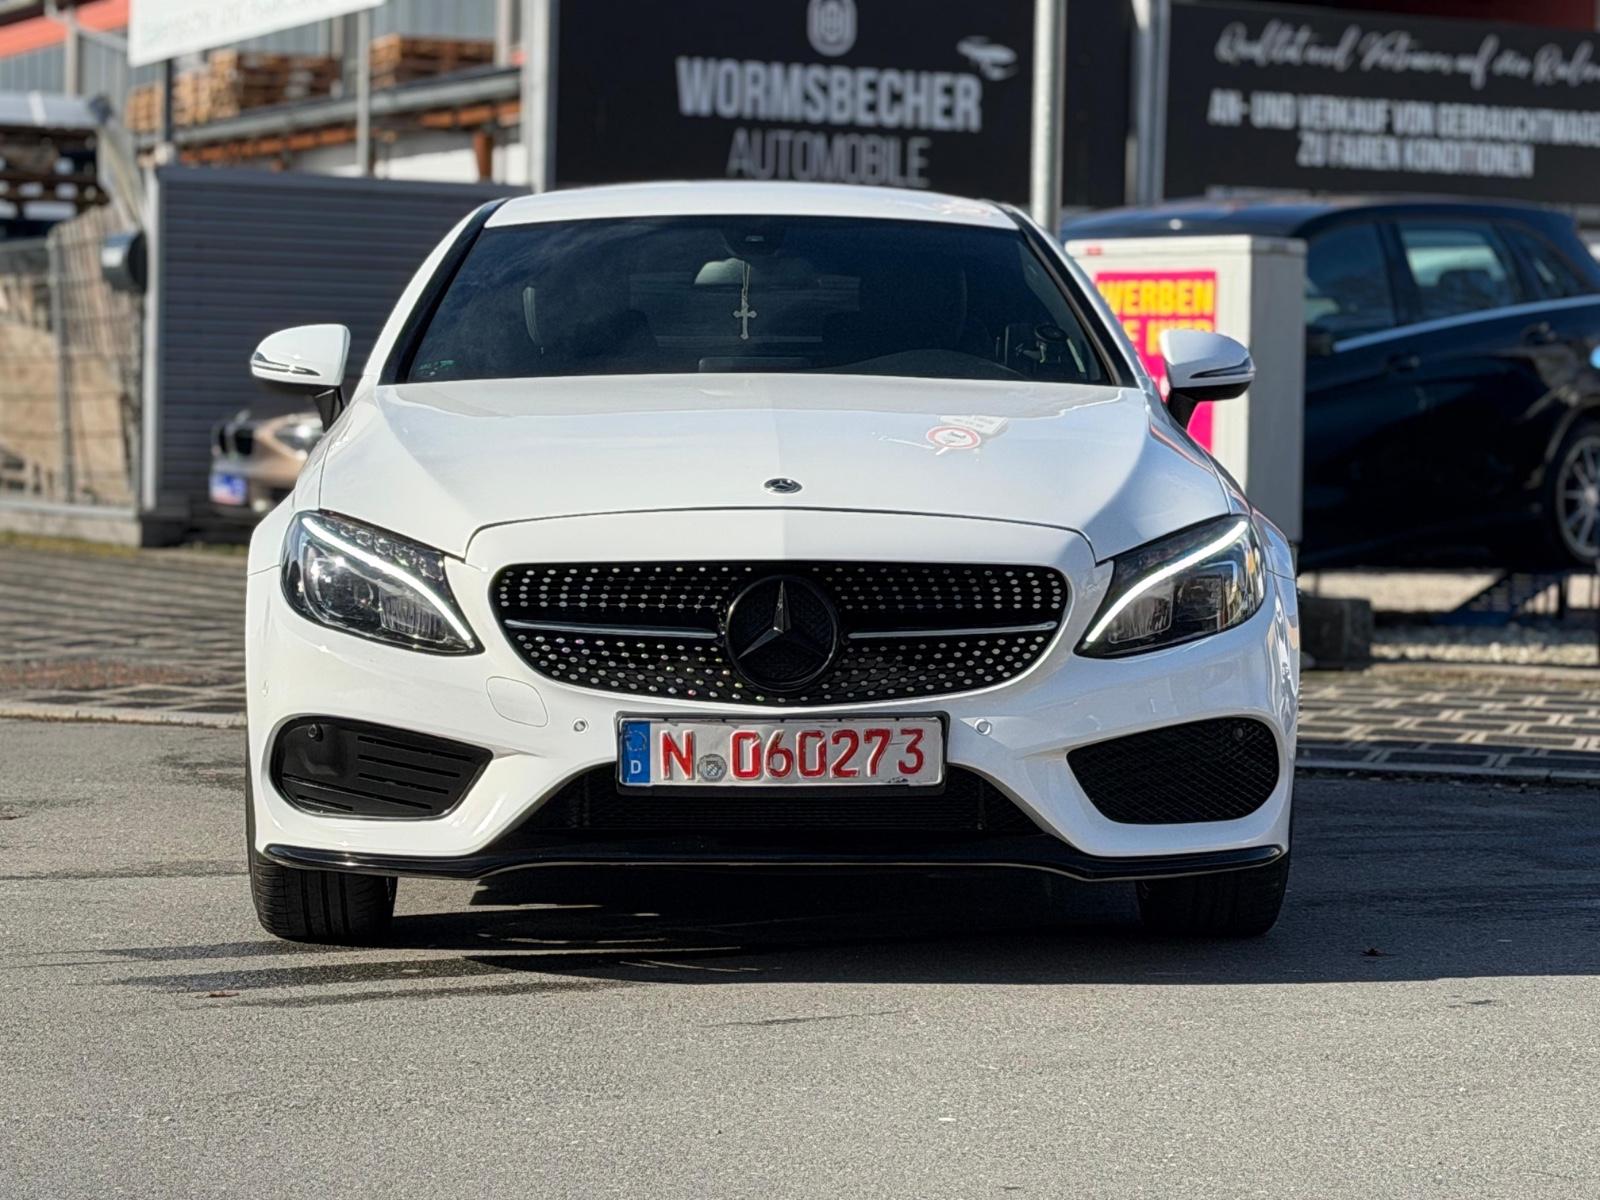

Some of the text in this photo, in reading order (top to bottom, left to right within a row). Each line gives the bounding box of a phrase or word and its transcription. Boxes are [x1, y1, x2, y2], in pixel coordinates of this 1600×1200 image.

[676, 56, 982, 132] WORMSBECHER
[1250, 91, 1296, 129] UND
[1298, 94, 1389, 133] VERKAUF
[1391, 100, 1433, 136] VON
[726, 127, 932, 188] AUTOMOBILE
[1403, 138, 1535, 178] KONDITIONEN
[630, 761, 642, 774] D
[660, 728, 924, 780] N 060273
